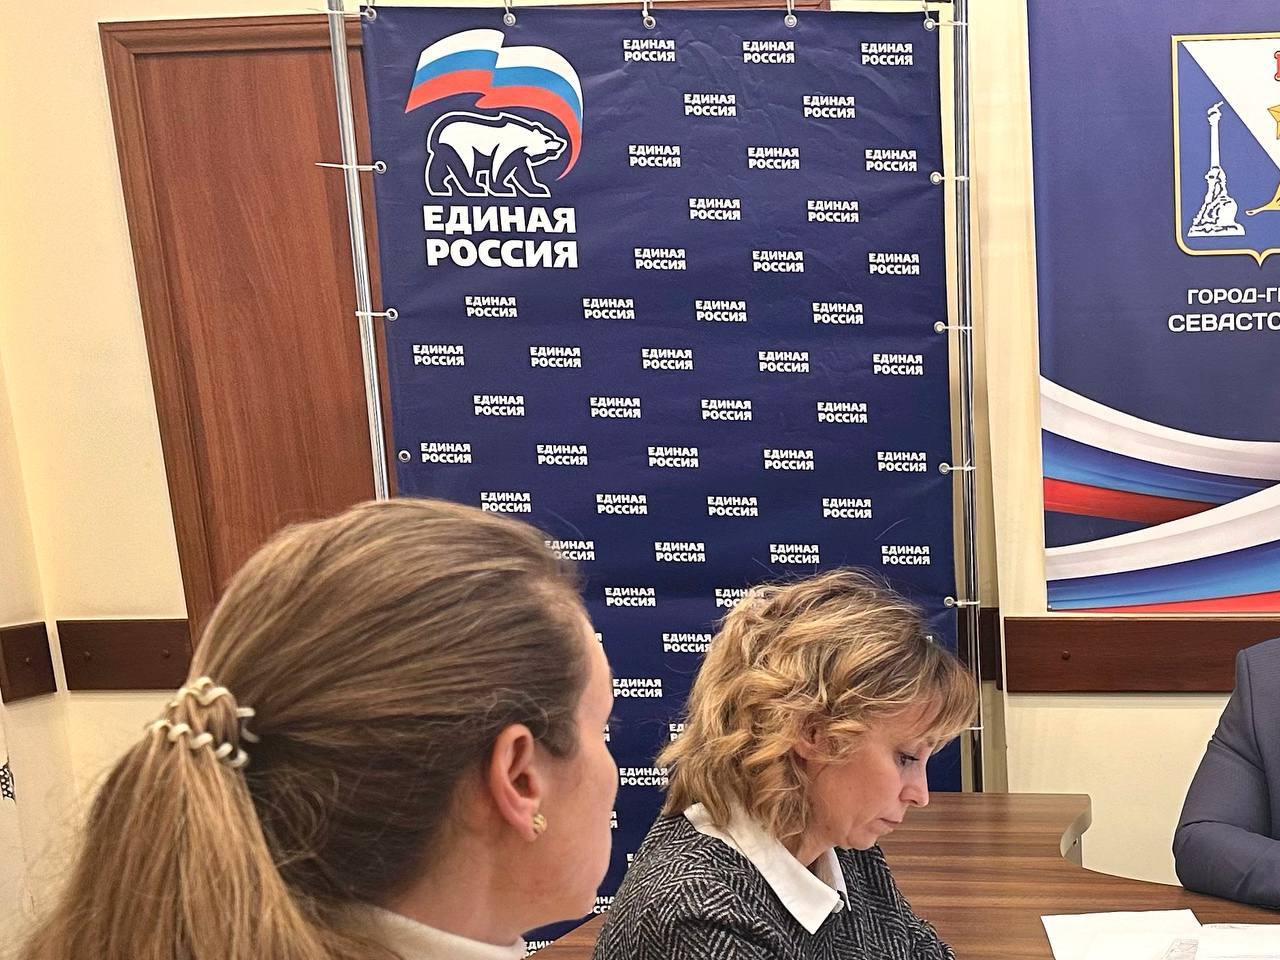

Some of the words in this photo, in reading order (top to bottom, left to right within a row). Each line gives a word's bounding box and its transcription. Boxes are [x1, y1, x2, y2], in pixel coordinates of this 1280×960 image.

[623, 40, 674, 50] ЕДИНАЯ
[743, 41, 794, 52] ЕДИНАЯ
[861, 43, 912, 54] ЕДИНАЯ
[624, 51, 675, 62] РОССИЯ
[744, 53, 794, 63] РОССИЯ
[862, 55, 913, 65] РОССИЯ
[684, 94, 735, 104] ЕДИНАЯ
[803, 96, 854, 106] ЕДИНАЯ
[685, 105, 736, 116] РОССИЯ
[804, 107, 855, 118] РОССИЯ
[629, 145, 680, 156] ЕДИНАЯ
[748, 148, 799, 158] ЕДИНАЯ
[866, 150, 916, 160] ЕДИНАЯ
[630, 157, 681, 167] РОССИЯ
[749, 159, 799, 169] РОССИЯ
[866, 161, 917, 171] РОССИЯ
[689, 199, 740, 209] ЕДИНАЯ
[808, 200, 858, 211] ЕДИНАЯ
[424, 205, 576, 235] ЕДИНАЯ
[690, 210, 740, 220] РОССИЯ
[808, 212, 859, 222] РОССИЯ
[427, 238, 578, 268] РОССИЯ
[635, 249, 685, 259] ЕДИНАЯ
[753, 251, 803, 261] ЕДИНАЯ
[869, 253, 919, 263] ЕДИНАЯ
[636, 260, 686, 270] РОССИЯ
[754, 262, 804, 272] РОССИЯ
[870, 264, 919, 274] РОССИЯ
[465, 296, 516, 306] ЕДИНАЯ
[583, 299, 633, 308] ЕДИНАЯ
[696, 301, 745, 310] ЕДИНАЯ
[467, 307, 517, 317] РОССИЯ
[813, 303, 862, 313] ЕДИНАЯ
[585, 309, 634, 319] РОССИЯ
[697, 311, 747, 321] РОССИЯ
[814, 314, 863, 324] РОССИЯ
[413, 345, 463, 355] ЕДИНАЯ
[530, 347, 580, 357] ЕДИНАЯ
[642, 349, 692, 359] ЕДИНАЯ
[414, 356, 464, 366] РОССИЯ
[759, 351, 808, 361] ЕДИНАЯ
[873, 354, 922, 364] ЕДИНАЯ
[532, 358, 582, 368] РОССИЯ
[643, 360, 693, 370] РОССИЯ
[760, 362, 809, 372] РОССИЯ
[874, 365, 923, 375] РОССИЯ
[474, 395, 524, 405] ЕДИНАЯ
[590, 397, 640, 407] ЕДИНАЯ
[701, 400, 751, 409] ЕДИНАЯ
[475, 406, 524, 416] РОССИЯ
[817, 402, 866, 412] ЕДИНАЯ
[591, 408, 641, 418] РОССИЯ
[702, 410, 752, 420] РОССИЯ
[818, 413, 867, 423] РОССИЯ
[421, 443, 470, 453] ЕДИНАЯ
[537, 445, 587, 454] ЕДИНАЯ
[648, 447, 698, 457] ЕДИНАЯ
[422, 453, 471, 463] РОССИЯ
[764, 450, 813, 459] ЕДИНАЯ
[878, 452, 926, 461] ЕДИНАЯ
[538, 455, 587, 465] РОССИЯ
[649, 457, 698, 467] РОССИЯ
[765, 460, 814, 470] РОССИЯ
[878, 462, 926, 471] РОССИЯ
[481, 492, 530, 502] ЕДИНАЯ
[597, 494, 646, 504] ЕДИНАЯ
[708, 496, 757, 506] ЕДИНАЯ
[482, 503, 531, 512] РОССИЯ
[823, 498, 871, 508] ЕДИНАЯ
[598, 505, 647, 514] РОССИЯ
[709, 507, 758, 516] РОССИЯ
[824, 509, 872, 518] РОССИЯ
[655, 542, 704, 551] ЕДИНАЯ
[770, 544, 819, 553] ЕДИНАЯ
[882, 546, 929, 555] ЕДИНАЯ
[554, 551, 595, 561] ОССИЯ
[656, 552, 705, 562] РОССИЯ
[771, 554, 820, 563] РОССИЯ
[883, 556, 930, 564] РОССИЯ
[605, 588, 655, 596] ЕДИНАЯ
[607, 597, 656, 606] РОССИЯ
[663, 633, 711, 643] ЕДИНАЯ
[664, 643, 711, 652] РОССИЯ
[613, 679, 662, 688] ЕДИНАЯ
[613, 689, 662, 697] РОССИЯ
[620, 767, 668, 776] ЕДИНАЯ
[621, 777, 668, 785] РОССИЯ
